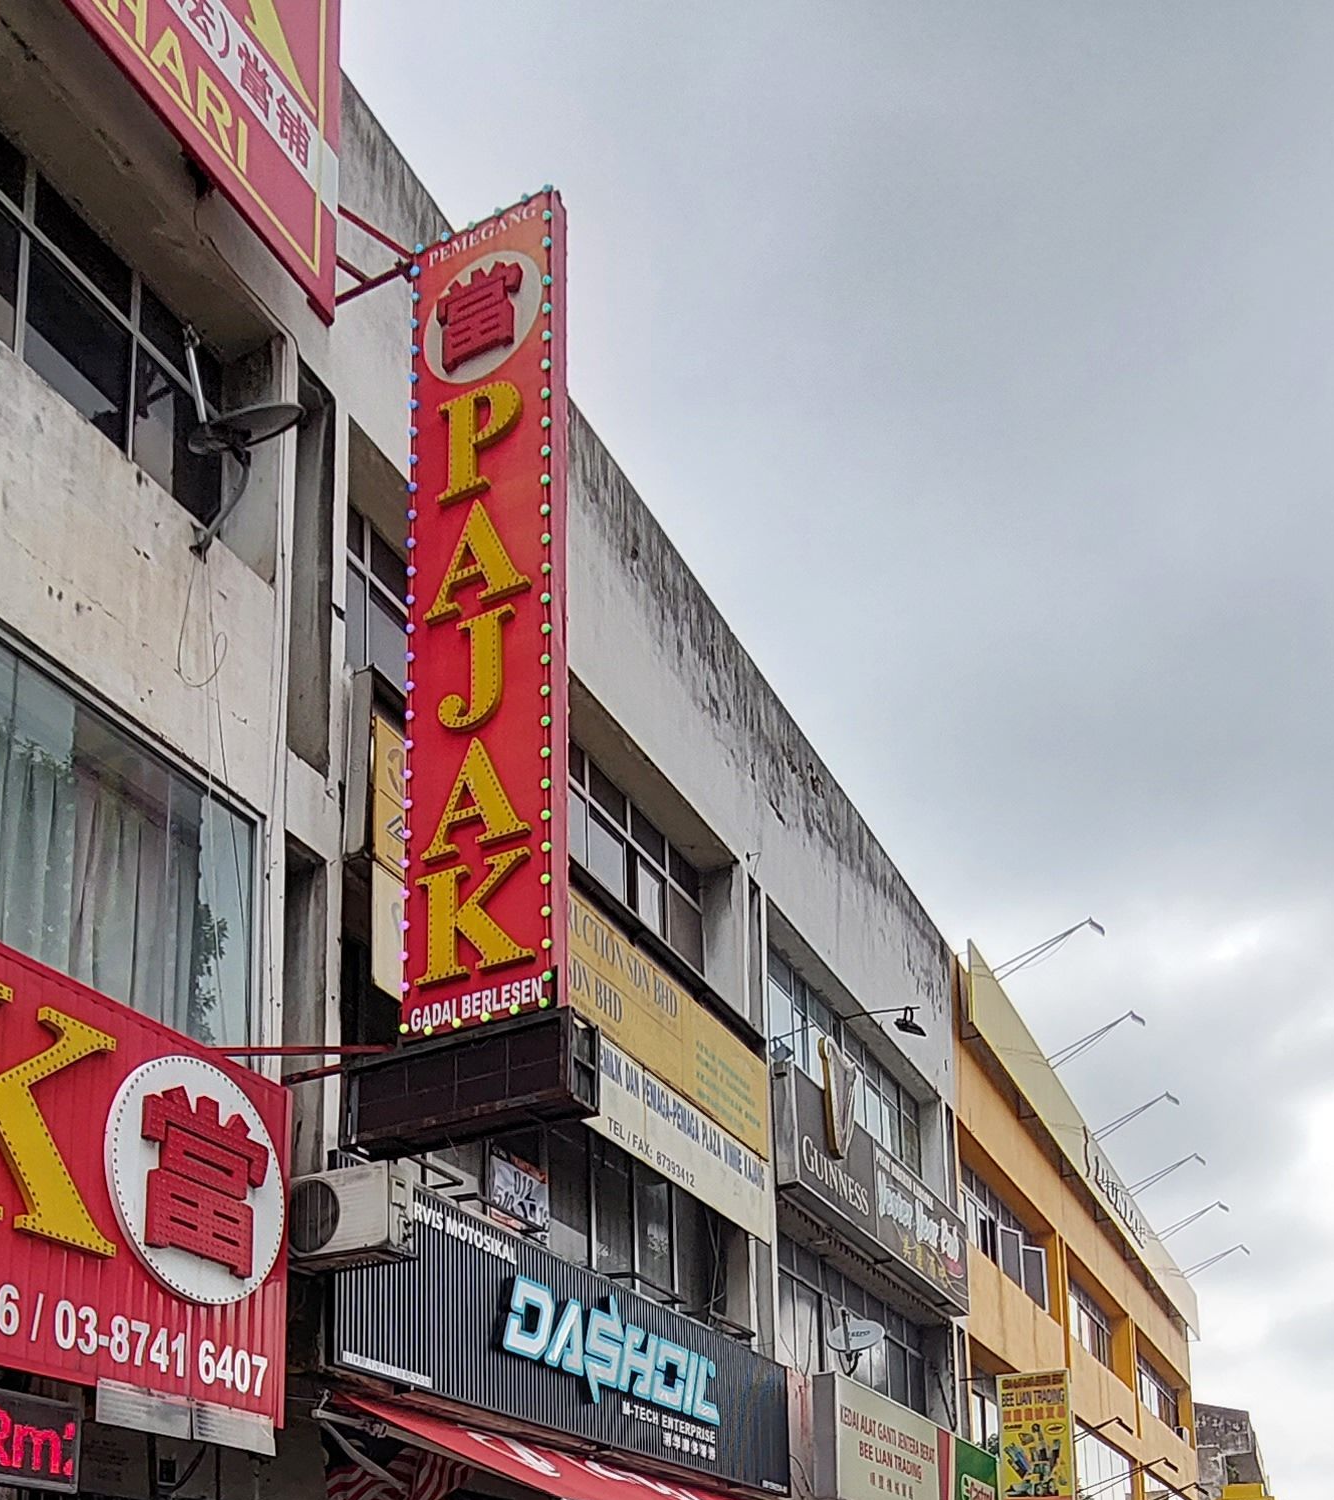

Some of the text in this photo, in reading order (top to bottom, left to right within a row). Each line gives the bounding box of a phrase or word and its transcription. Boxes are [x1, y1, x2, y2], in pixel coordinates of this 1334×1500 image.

[427, 203, 537, 268] PEMEGANG
[415, 381, 536, 987] PAJAK
[411, 976, 543, 1033] GADAI BERLESEN
[607, 1116, 627, 1141] TEL
[633, 1134, 653, 1160] FAX:
[802, 1135, 870, 1217] GUINNESS
[445, 1216, 518, 1266] MOTOSIKAL
[54, 1299, 189, 1379] 03-8741
[198, 1347, 269, 1398] 6407
[622, 1401, 716, 1445] M-TECH ENTERPRISE
[859, 1440, 923, 1481] BEE LIAN TRADING
